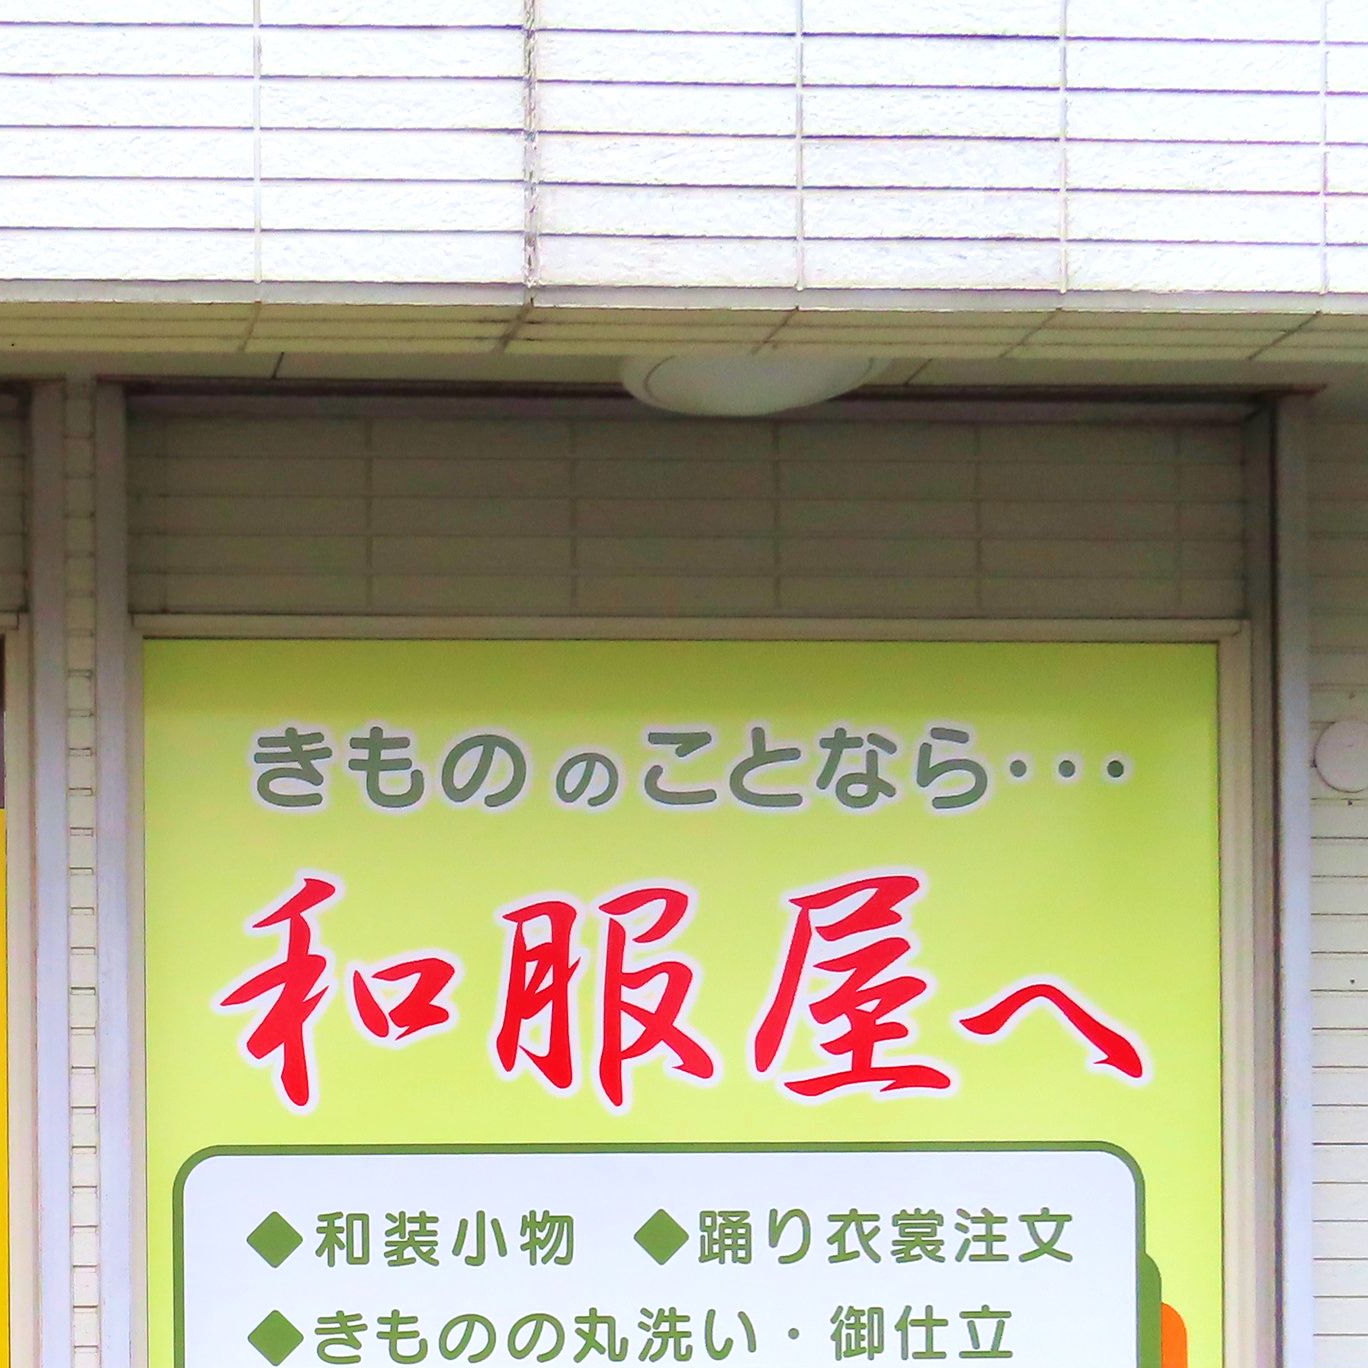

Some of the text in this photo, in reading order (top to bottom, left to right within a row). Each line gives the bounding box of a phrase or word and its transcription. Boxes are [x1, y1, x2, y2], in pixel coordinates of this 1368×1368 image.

[220, 874, 1144, 1108] 和服屋へ
[314, 1208, 575, 1268] 和装小物
[697, 1205, 1074, 1265] 踊り衣裳注文
